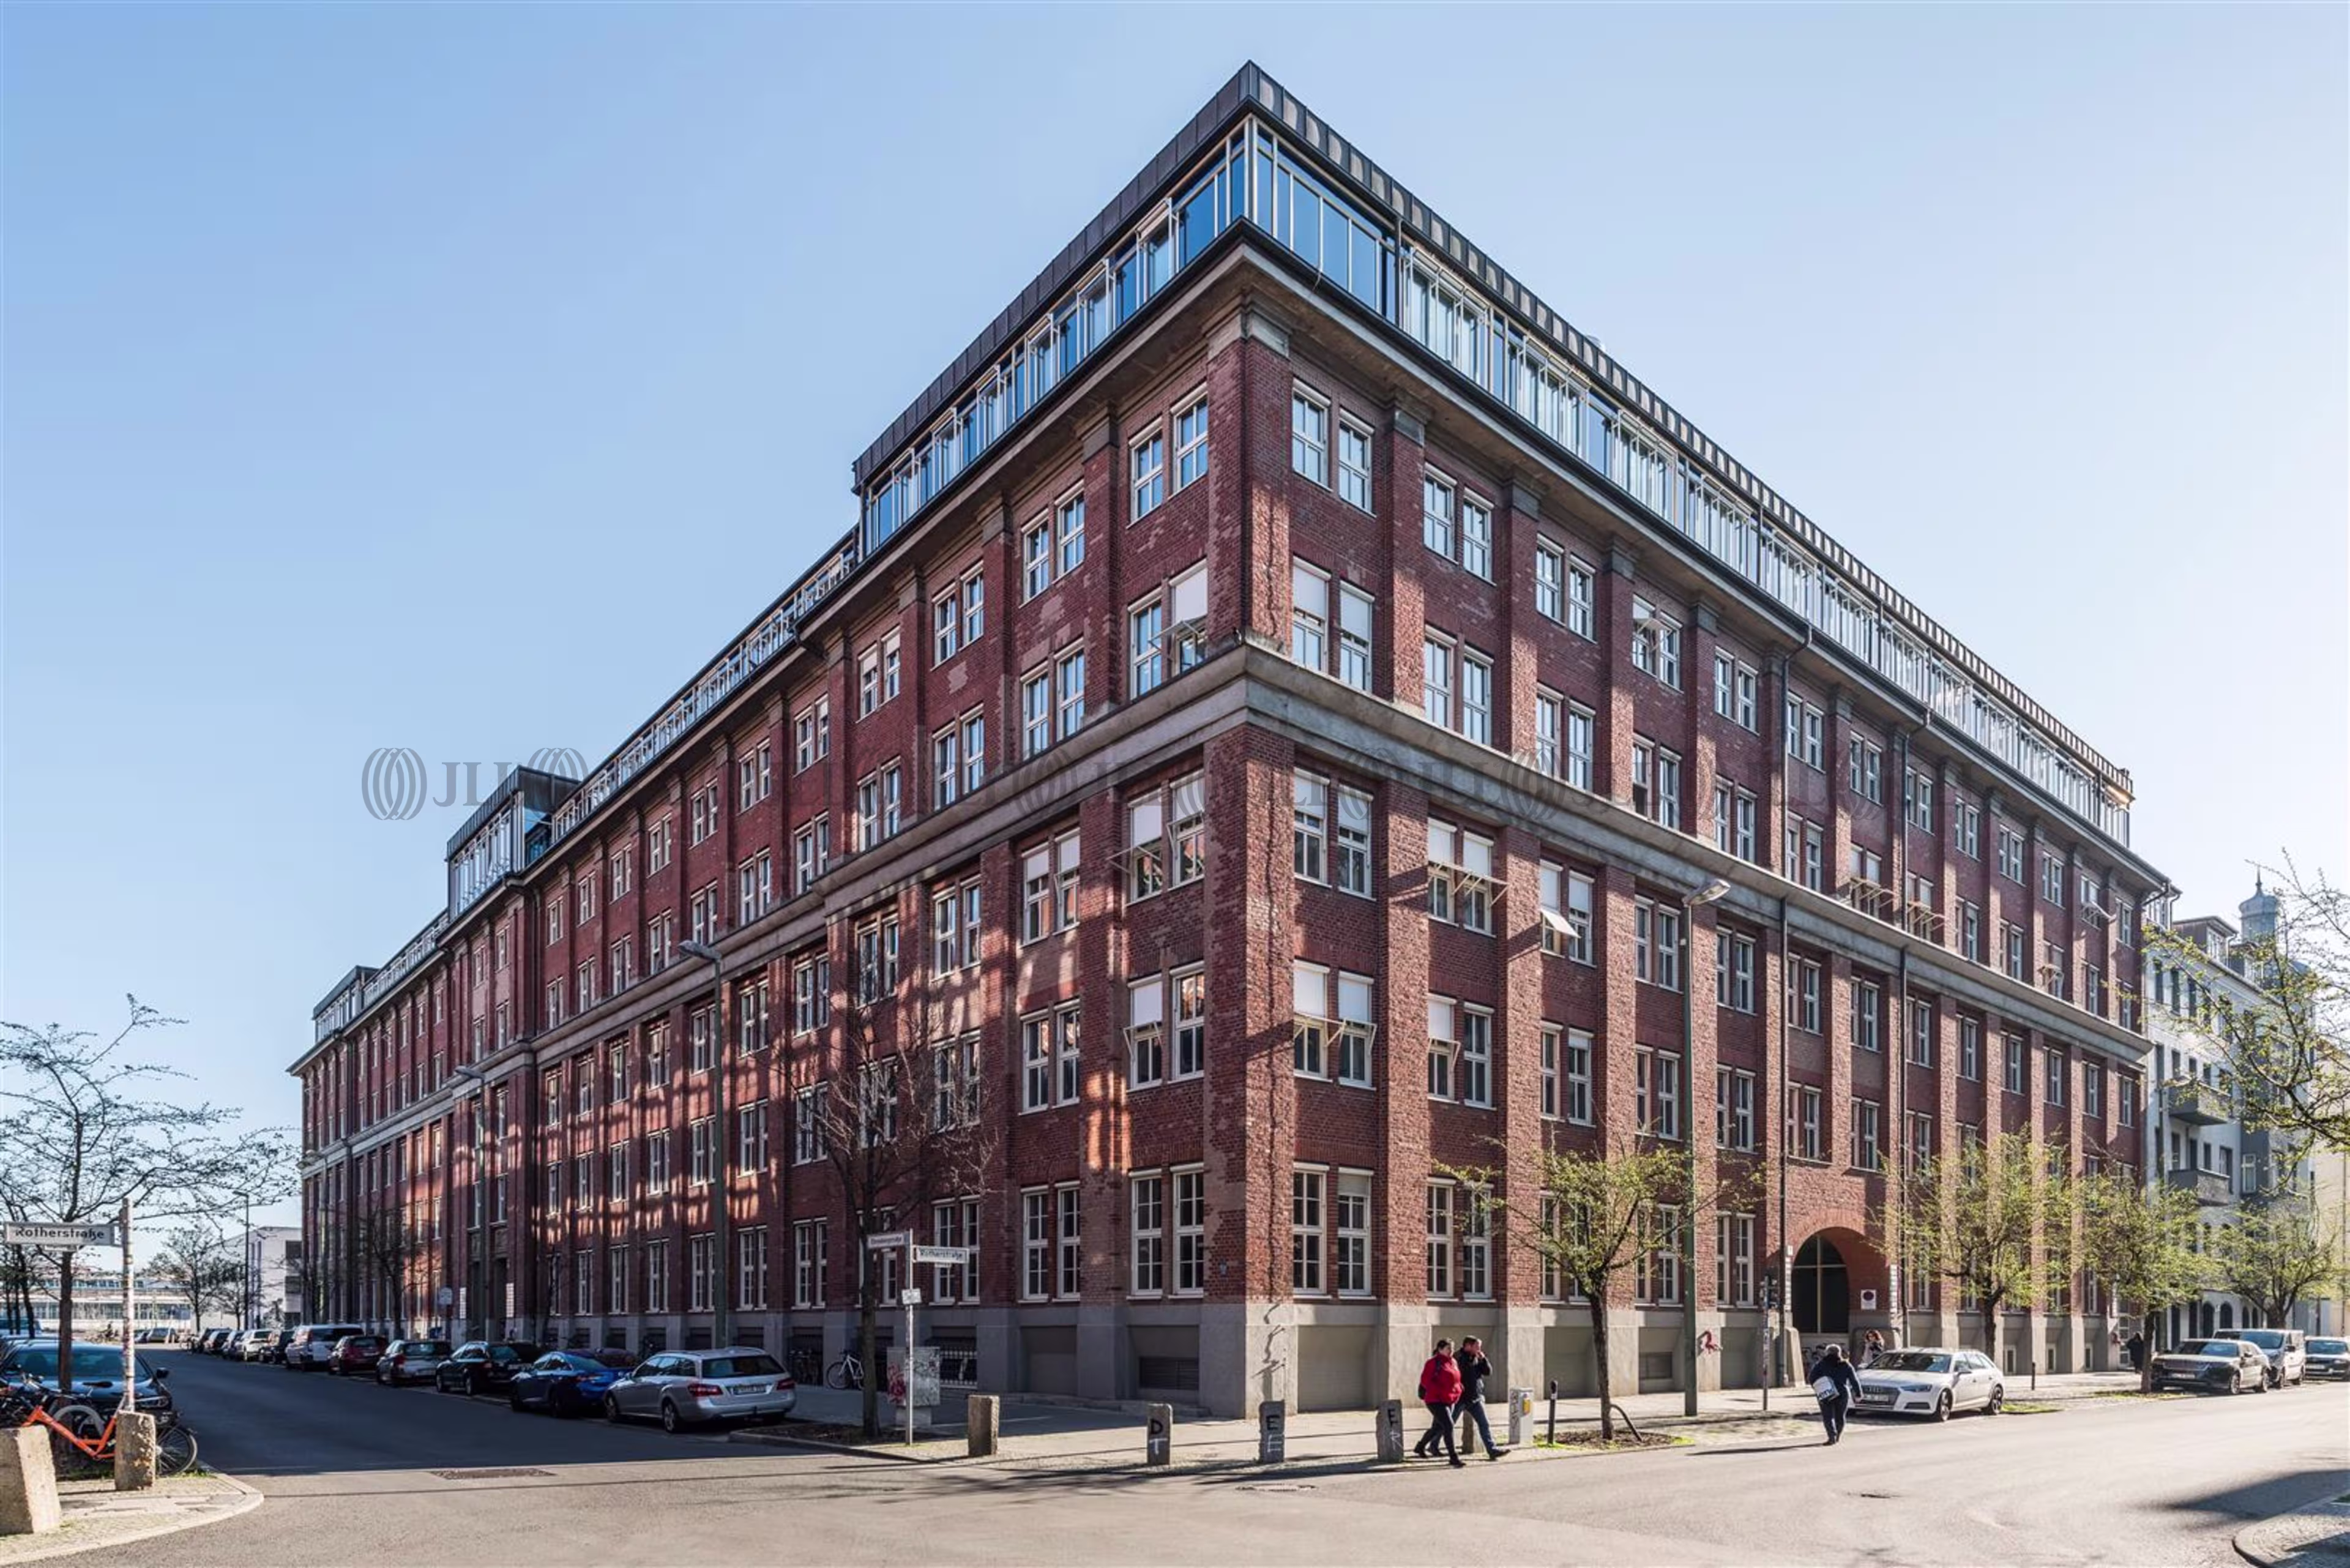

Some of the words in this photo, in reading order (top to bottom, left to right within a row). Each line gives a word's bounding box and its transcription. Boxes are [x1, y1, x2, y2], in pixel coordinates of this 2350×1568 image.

[15, 1226, 105, 1241] Rotherstraße
[1150, 1419, 1163, 1435] D
[1266, 1414, 1280, 1430] E
[1149, 1438, 1168, 1455] T
